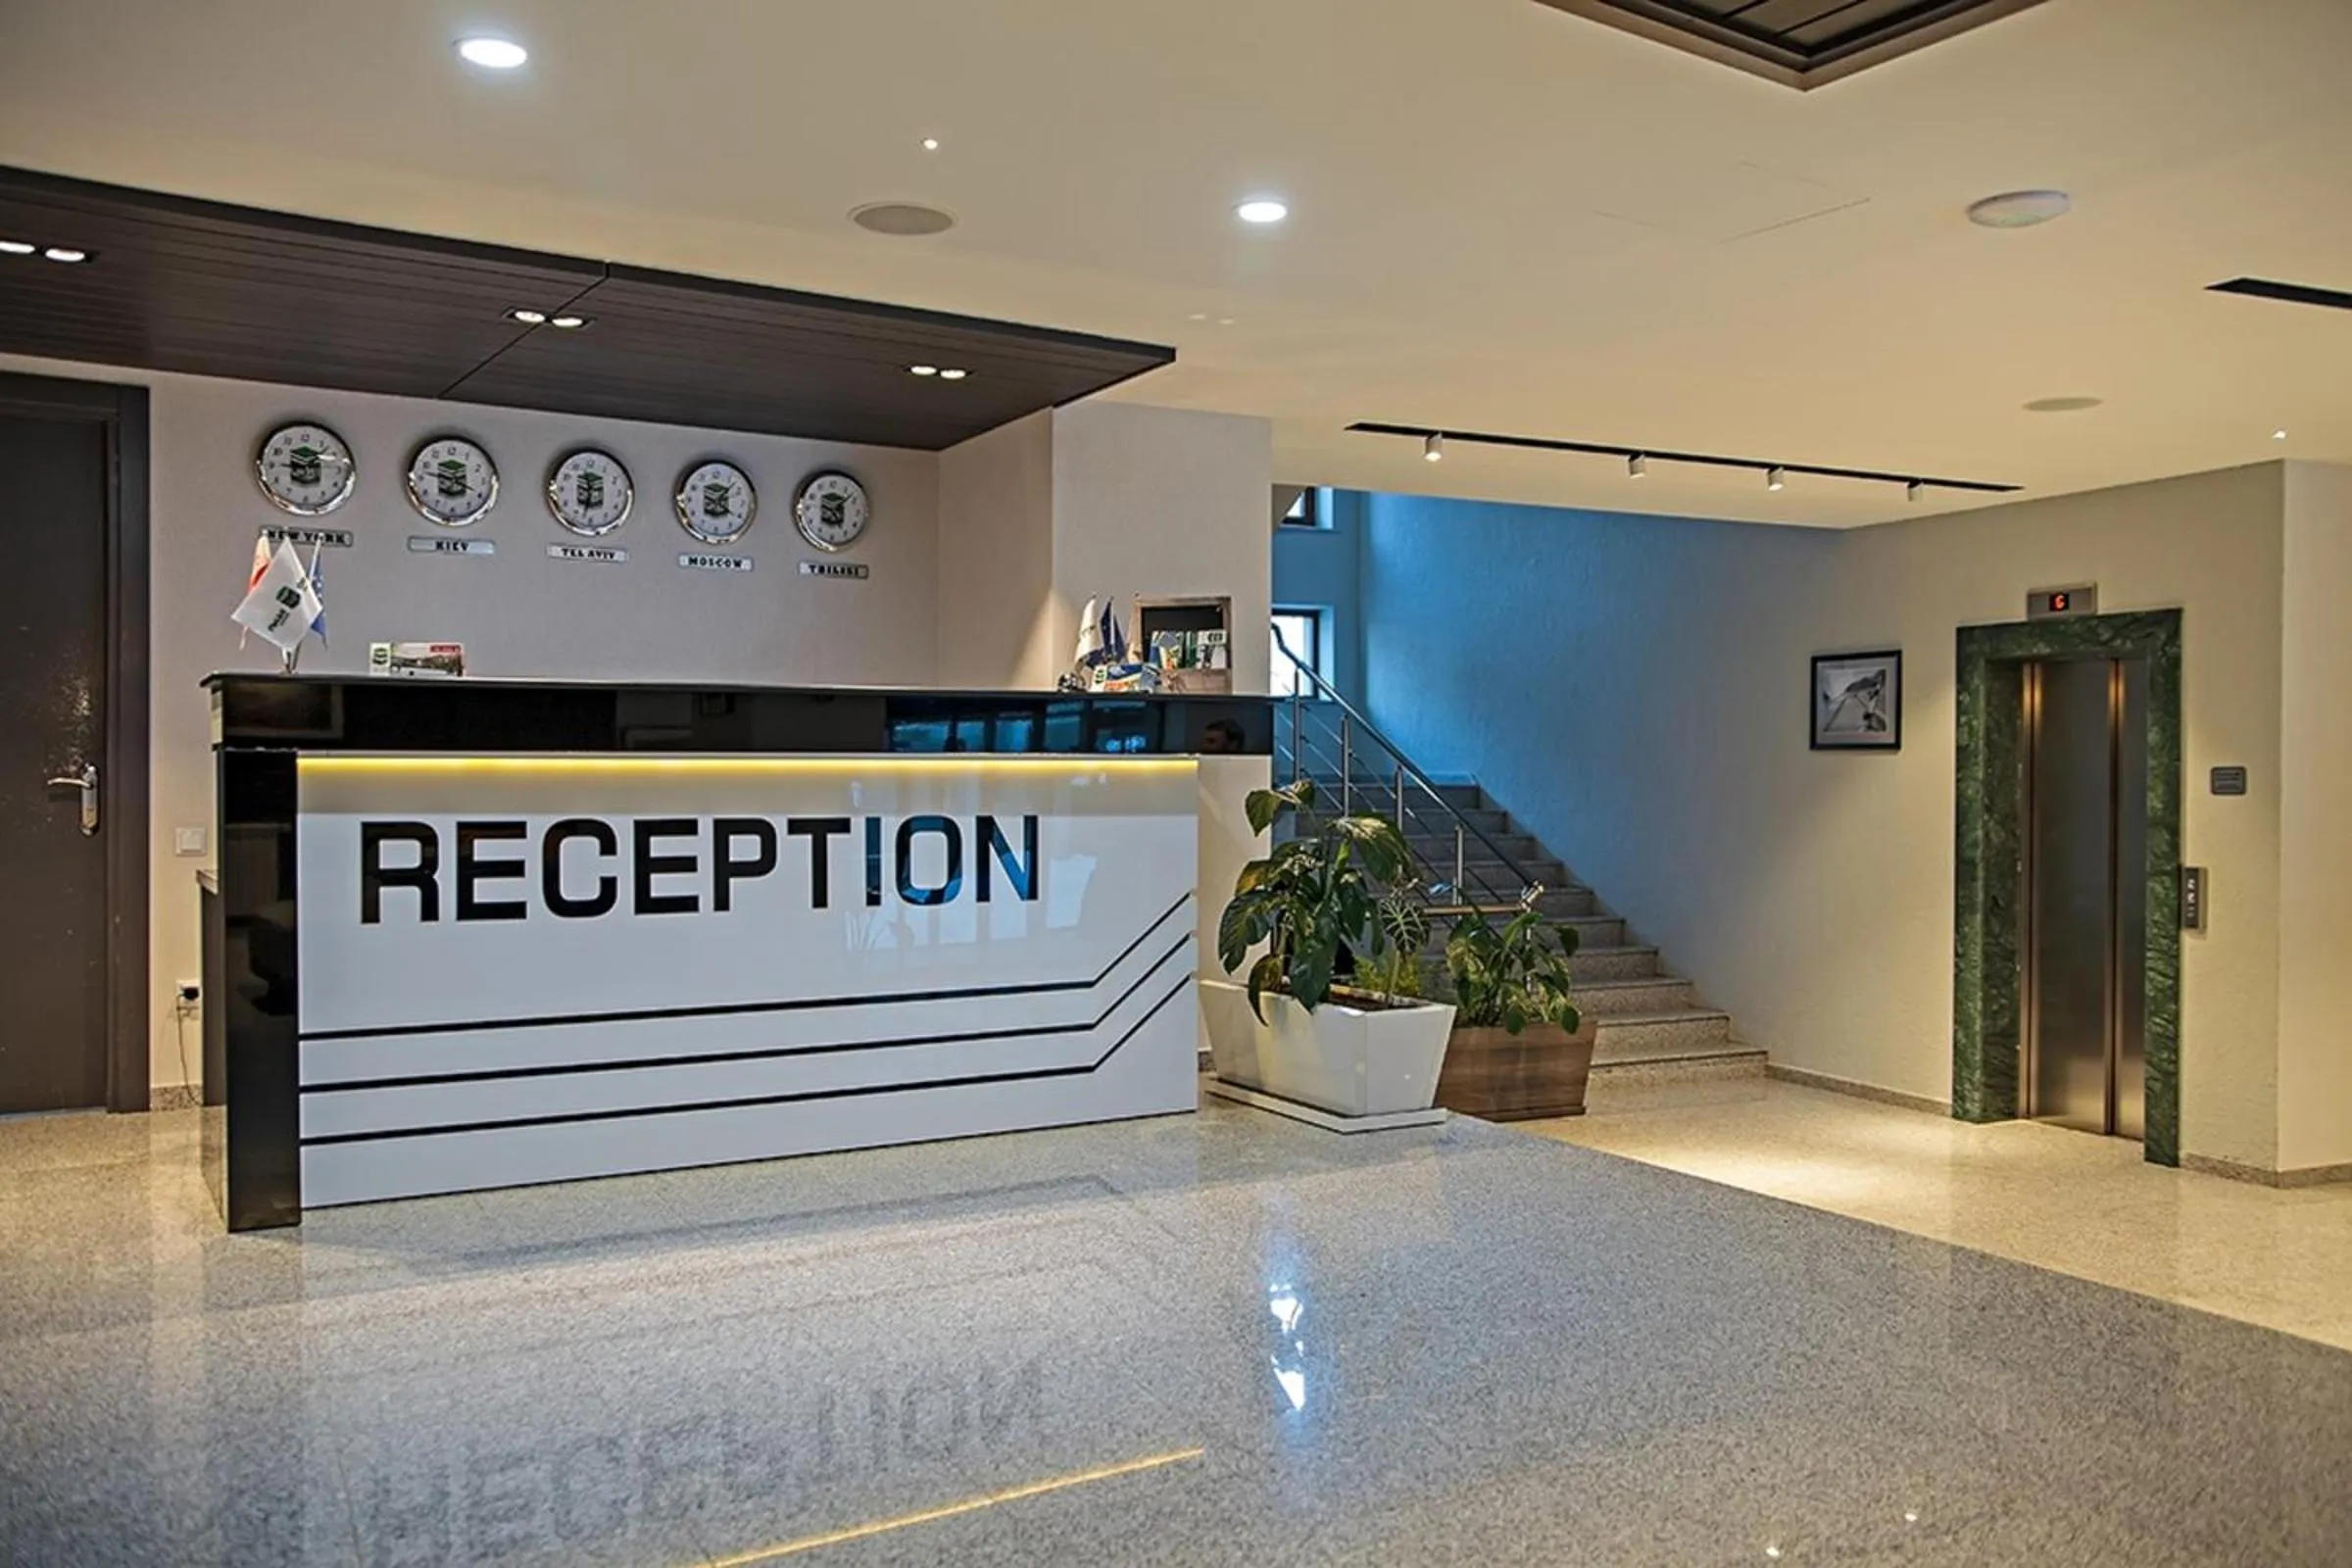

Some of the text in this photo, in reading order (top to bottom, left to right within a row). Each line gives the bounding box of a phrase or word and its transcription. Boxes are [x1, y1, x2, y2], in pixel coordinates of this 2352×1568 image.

[435, 540, 468, 552] KIEV
[562, 548, 615, 561] TEL AVIV
[689, 556, 742, 568] MOSCOW
[359, 814, 1039, 924] RECEPTION
